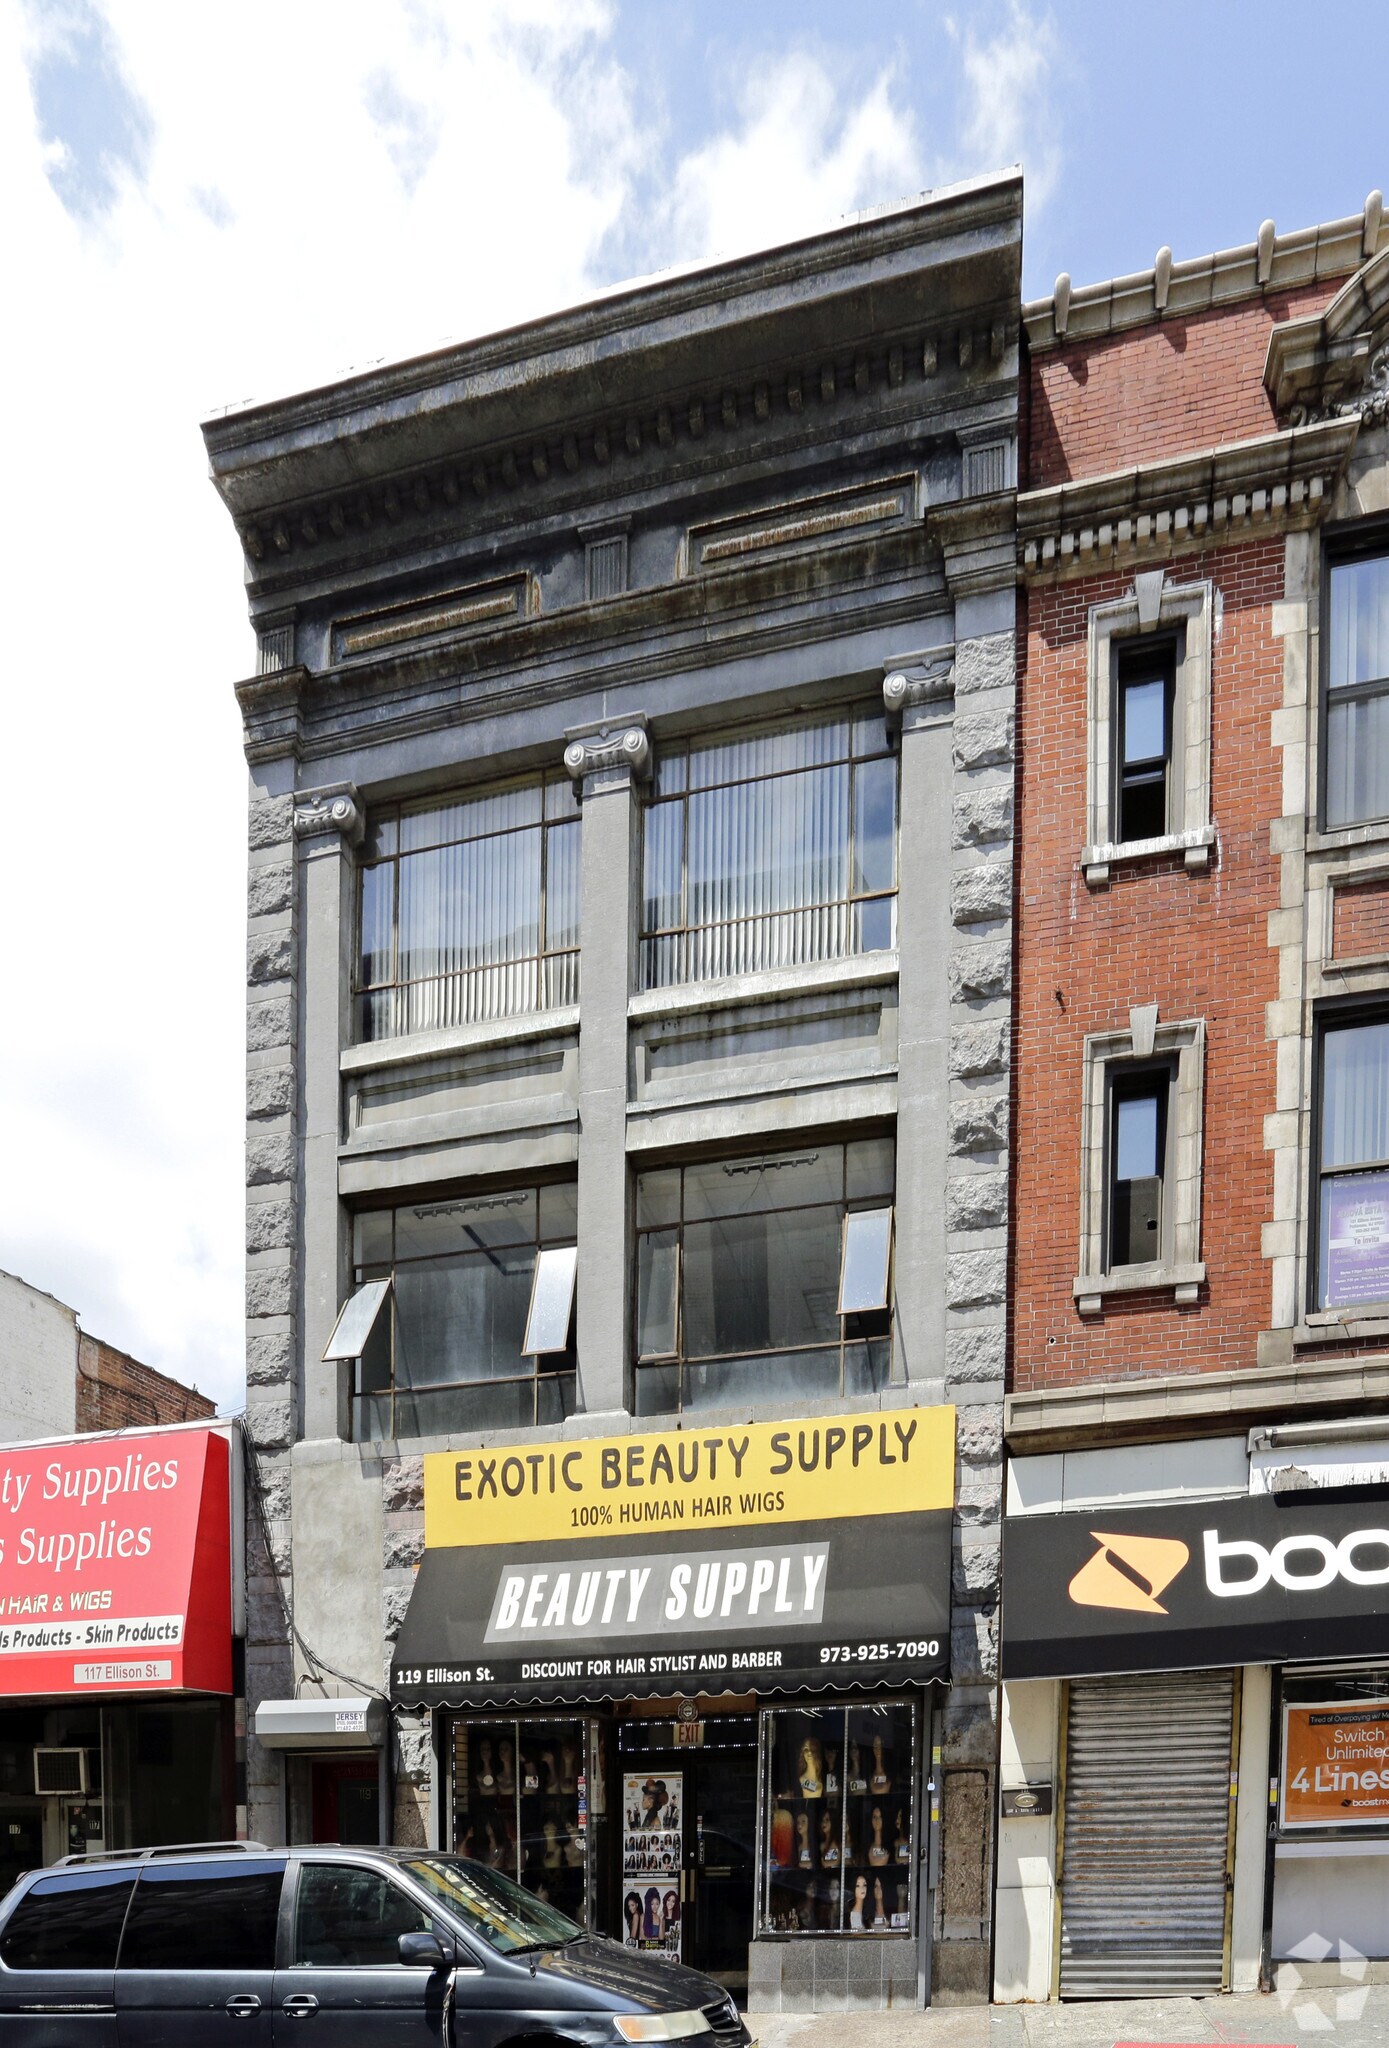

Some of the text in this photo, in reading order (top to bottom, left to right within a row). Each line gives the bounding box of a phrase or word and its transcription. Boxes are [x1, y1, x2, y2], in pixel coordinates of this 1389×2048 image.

[455, 1419, 917, 1501] EXOTIC BEAUTY SUPPLY
[43, 1453, 178, 1506] Supplies
[571, 1490, 785, 1527] 100% HUMAN HAIR WIGS
[17, 1520, 152, 1572] Supplies
[52, 1596, 63, 1612] &
[70, 1590, 112, 1611] WIGS
[495, 1555, 826, 1630] BEAUTY SUPPLY
[13, 1629, 72, 1648] Products
[85, 1624, 113, 1644] Skin
[117, 1622, 179, 1642] Products
[820, 1640, 939, 1663] 973-925-7090
[84, 1664, 160, 1680] 117 Ellison St.
[397, 1667, 495, 1684] 119 Ellison St.
[522, 1651, 782, 1679] DISCOUNT FOR HAIR STYLIST AND BARBER
[336, 1712, 364, 1721] JERSEY
[1311, 1716, 1326, 1724] Tired
[1334, 1713, 1371, 1724] Overpaying
[678, 1725, 700, 1743] EXIT
[1334, 1727, 1385, 1743] Switch
[1290, 1767, 1310, 1793] 4
